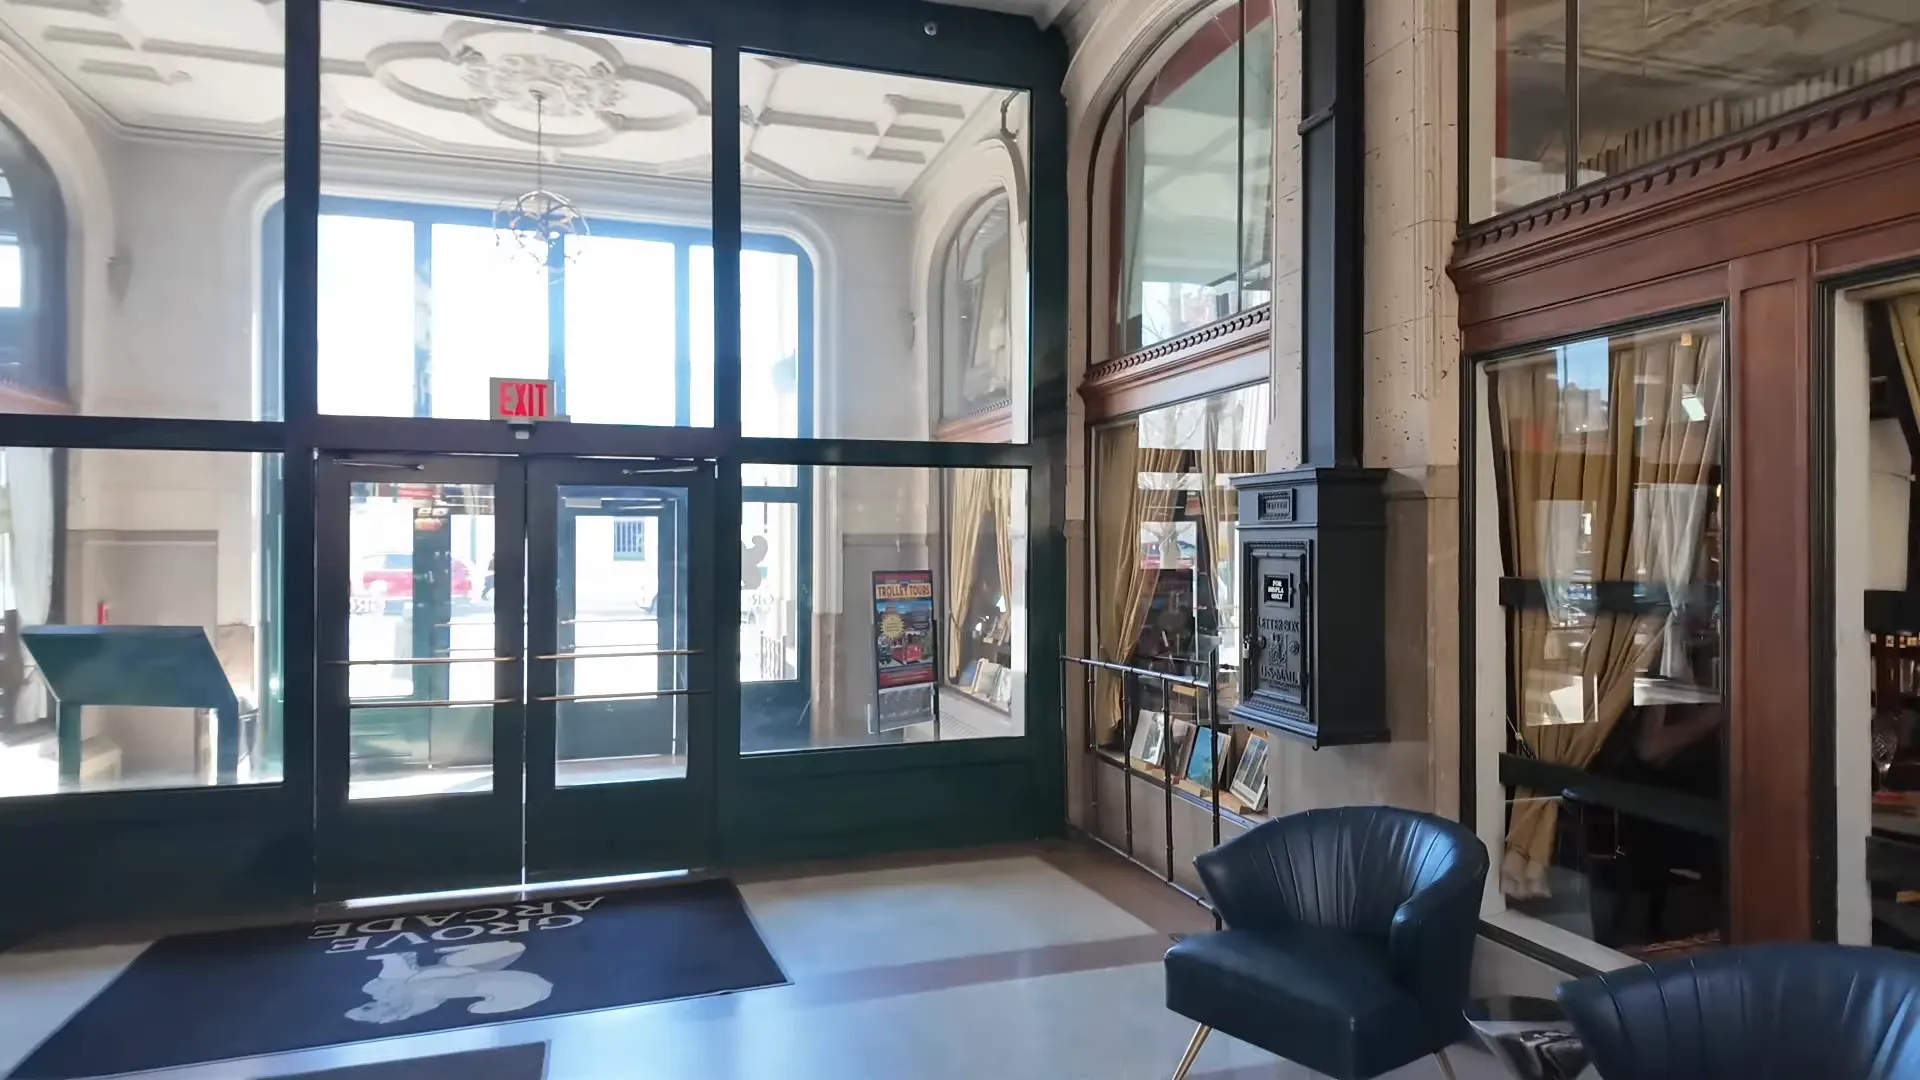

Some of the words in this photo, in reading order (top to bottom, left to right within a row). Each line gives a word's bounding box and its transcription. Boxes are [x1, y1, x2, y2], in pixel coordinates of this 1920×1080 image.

[500, 382, 548, 417] EXIT
[878, 585, 908, 597] TROLLEY
[908, 584, 930, 596] TOURS
[1272, 579, 1282, 587] FOR
[307, 896, 605, 940] ARCADE
[325, 914, 584, 954] GROVE
